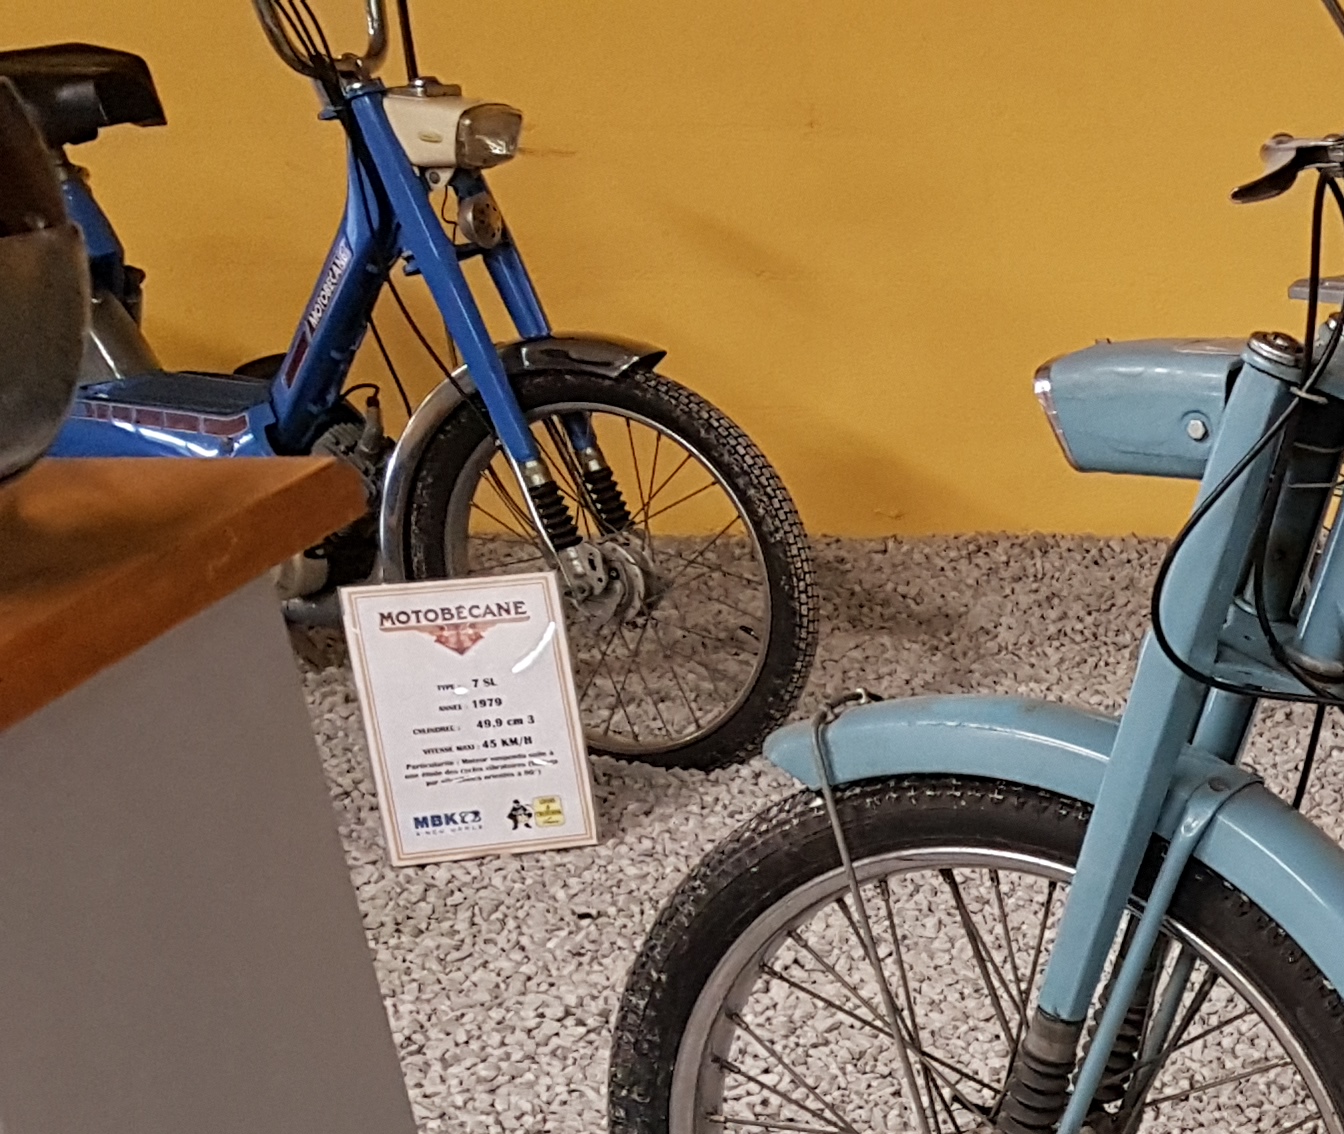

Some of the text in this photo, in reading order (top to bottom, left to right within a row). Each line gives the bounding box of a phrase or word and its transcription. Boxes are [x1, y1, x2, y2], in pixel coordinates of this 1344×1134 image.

[378, 600, 528, 627] MOTOBÉCANE
[471, 678, 479, 689] 7
[482, 677, 498, 687] SL
[472, 697, 503, 709] 1979
[476, 717, 503, 729] 49.9
[506, 718, 524, 727] cm
[527, 714, 536, 724] 3
[482, 738, 497, 750] 45
[501, 735, 534, 748] KM/H
[413, 812, 459, 830] MBK
